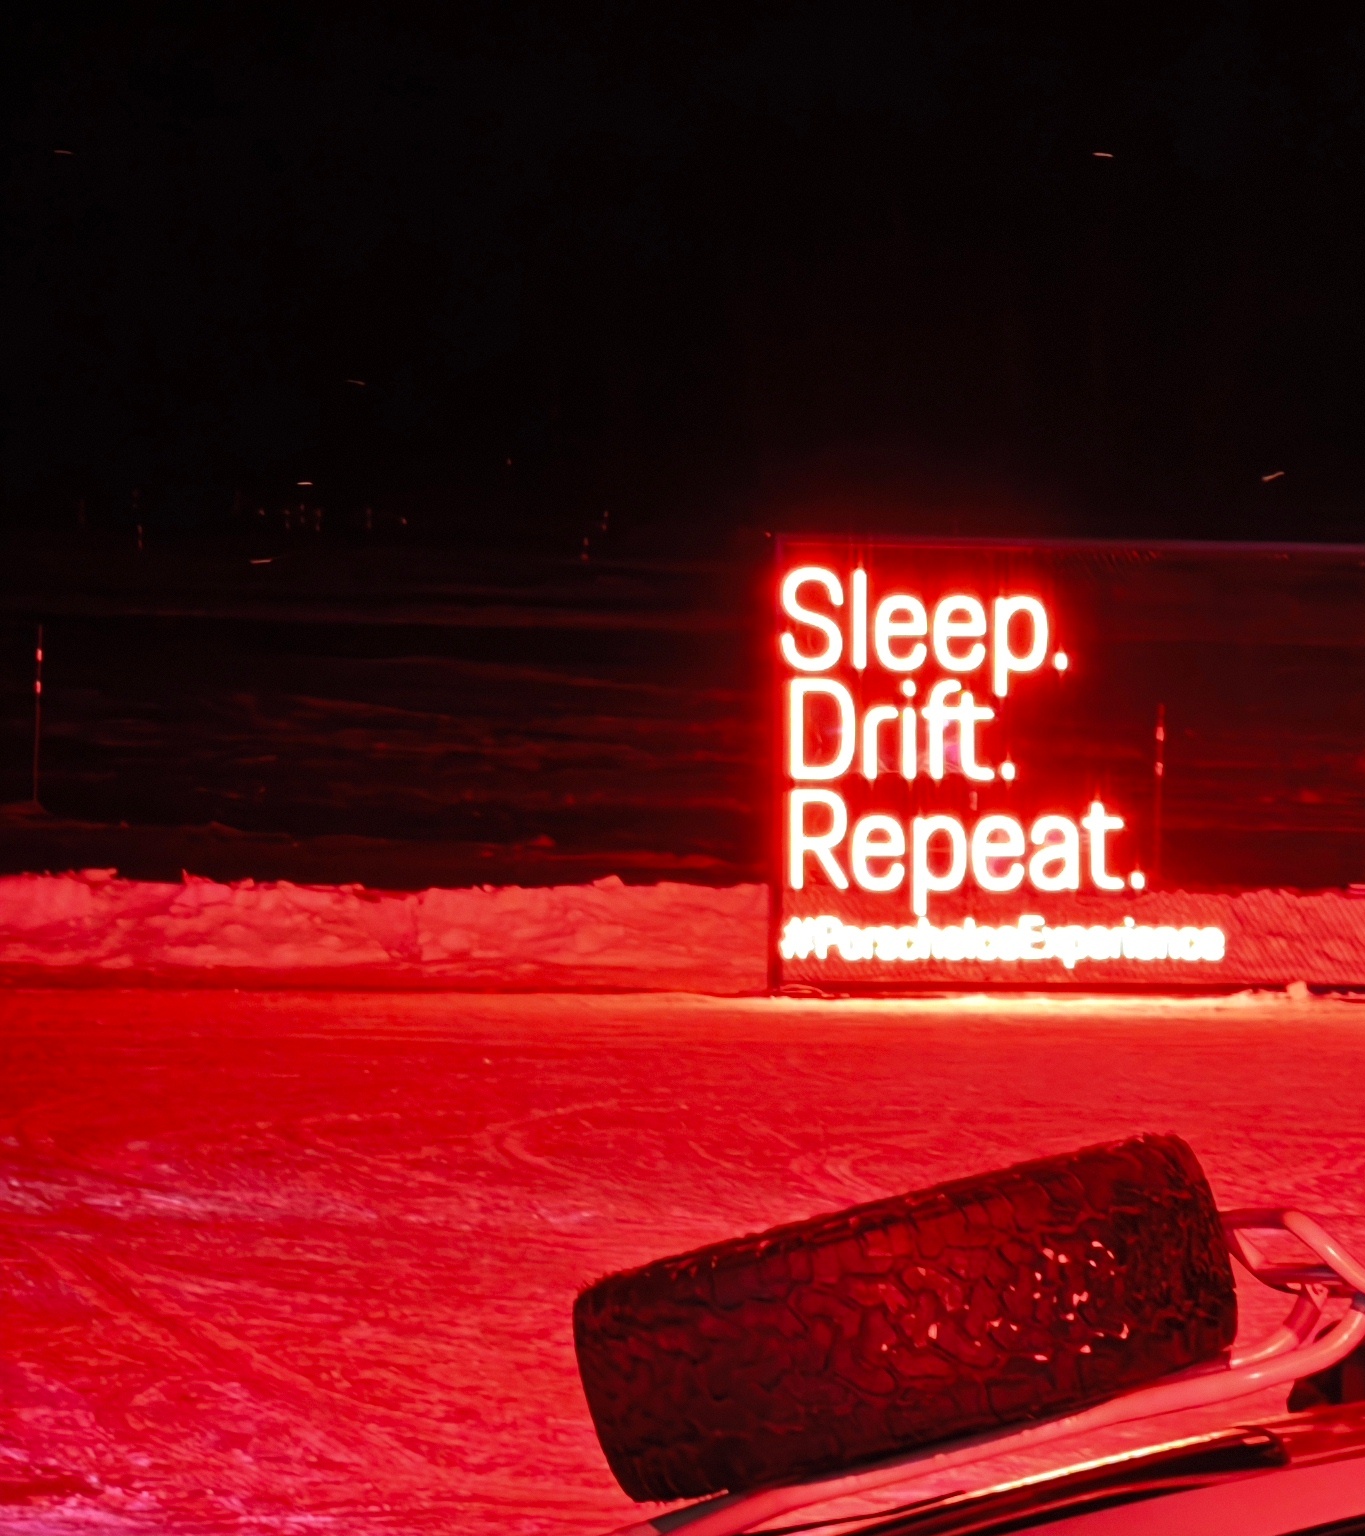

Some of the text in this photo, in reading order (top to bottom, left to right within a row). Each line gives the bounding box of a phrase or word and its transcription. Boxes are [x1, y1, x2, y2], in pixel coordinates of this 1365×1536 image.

[780, 565, 1069, 698] Sleep.
[788, 677, 1017, 782] Drift.
[788, 788, 1147, 917] Repeat.
